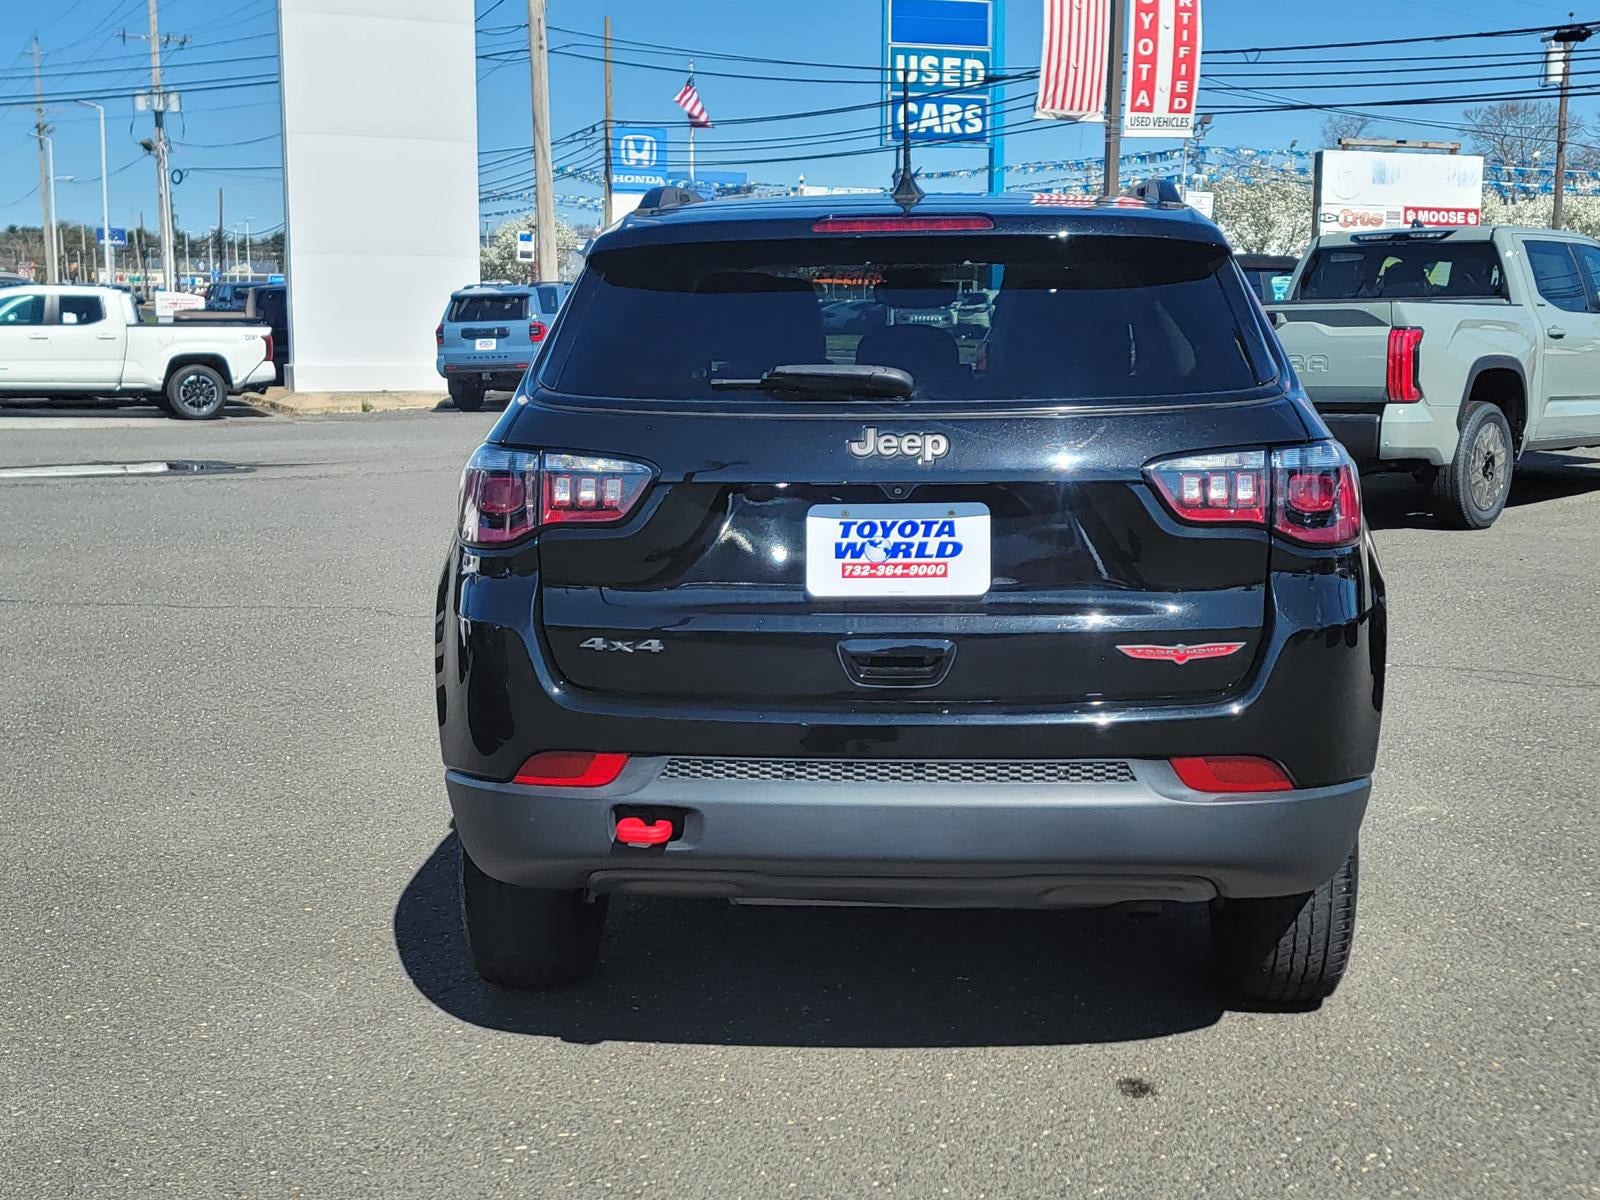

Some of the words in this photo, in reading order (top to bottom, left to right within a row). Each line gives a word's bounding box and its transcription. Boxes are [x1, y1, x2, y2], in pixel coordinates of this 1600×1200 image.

[896, 54, 986, 87] USED
[897, 102, 983, 134] CARS
[1130, 116, 1151, 127] USED
[1152, 116, 1190, 128] VEHICLES
[612, 174, 666, 185] HONDA
[1418, 210, 1466, 224] MOOSE
[848, 427, 949, 464] Jeep
[838, 519, 957, 539] TOYOTA
[843, 564, 946, 577] 732-364-9000
[578, 637, 665, 653] 4x4
